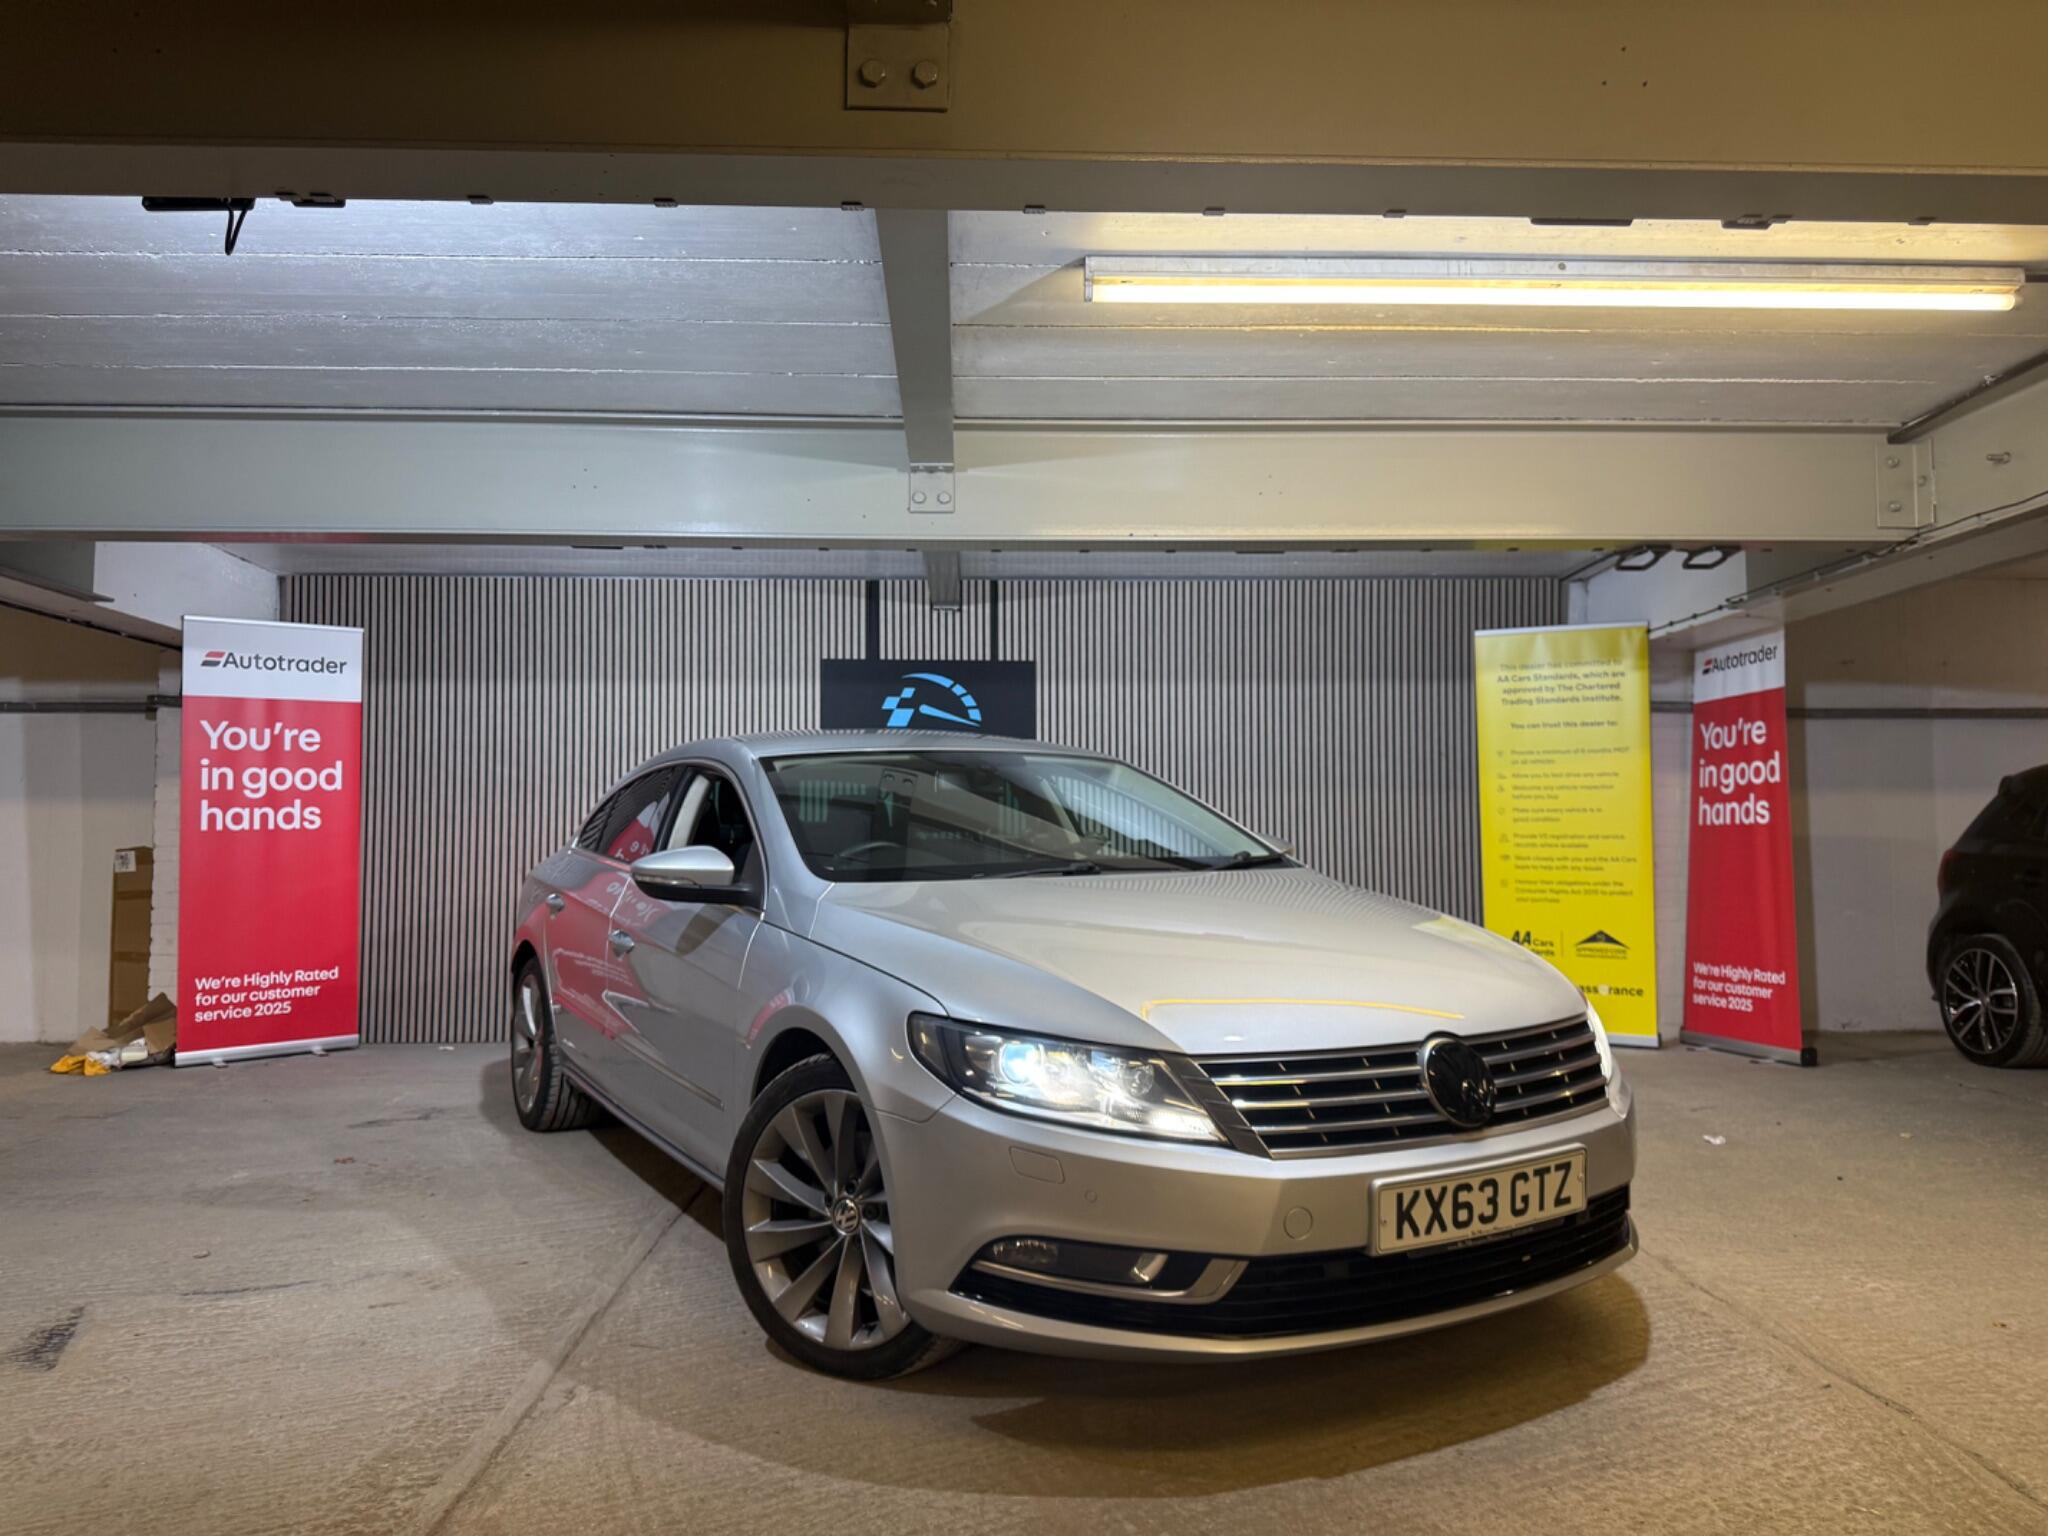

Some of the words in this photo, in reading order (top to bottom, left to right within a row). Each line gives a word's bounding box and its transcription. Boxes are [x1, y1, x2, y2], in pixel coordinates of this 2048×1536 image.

[222, 652, 347, 674] Autotrader
[1711, 644, 1778, 673] Autotrader
[200, 719, 321, 752] You're
[1700, 717, 1767, 750] You're
[200, 758, 234, 791] in
[242, 760, 343, 799] good
[1699, 758, 1717, 788] in
[1719, 750, 1780, 794] good
[200, 799, 322, 831] hands
[1699, 793, 1770, 826] hands
[195, 976, 241, 990] We're
[243, 970, 292, 988] Highly
[294, 966, 339, 982] Rated
[1693, 977, 1706, 990] for
[1707, 980, 1723, 992] our
[1724, 982, 1773, 999] customer
[1721, 965, 1752, 983] Highly
[1754, 968, 1785, 985] Rated
[195, 993, 217, 1006] for
[221, 991, 247, 1004] our
[249, 984, 321, 1001] customer
[1692, 993, 1727, 1008] service
[1728, 997, 1753, 1012] 2025
[195, 1006, 251, 1022] service
[254, 1001, 292, 1017] 2025
[1396, 1177, 1499, 1240] KX63
[1510, 1160, 1572, 1218] GTZ
